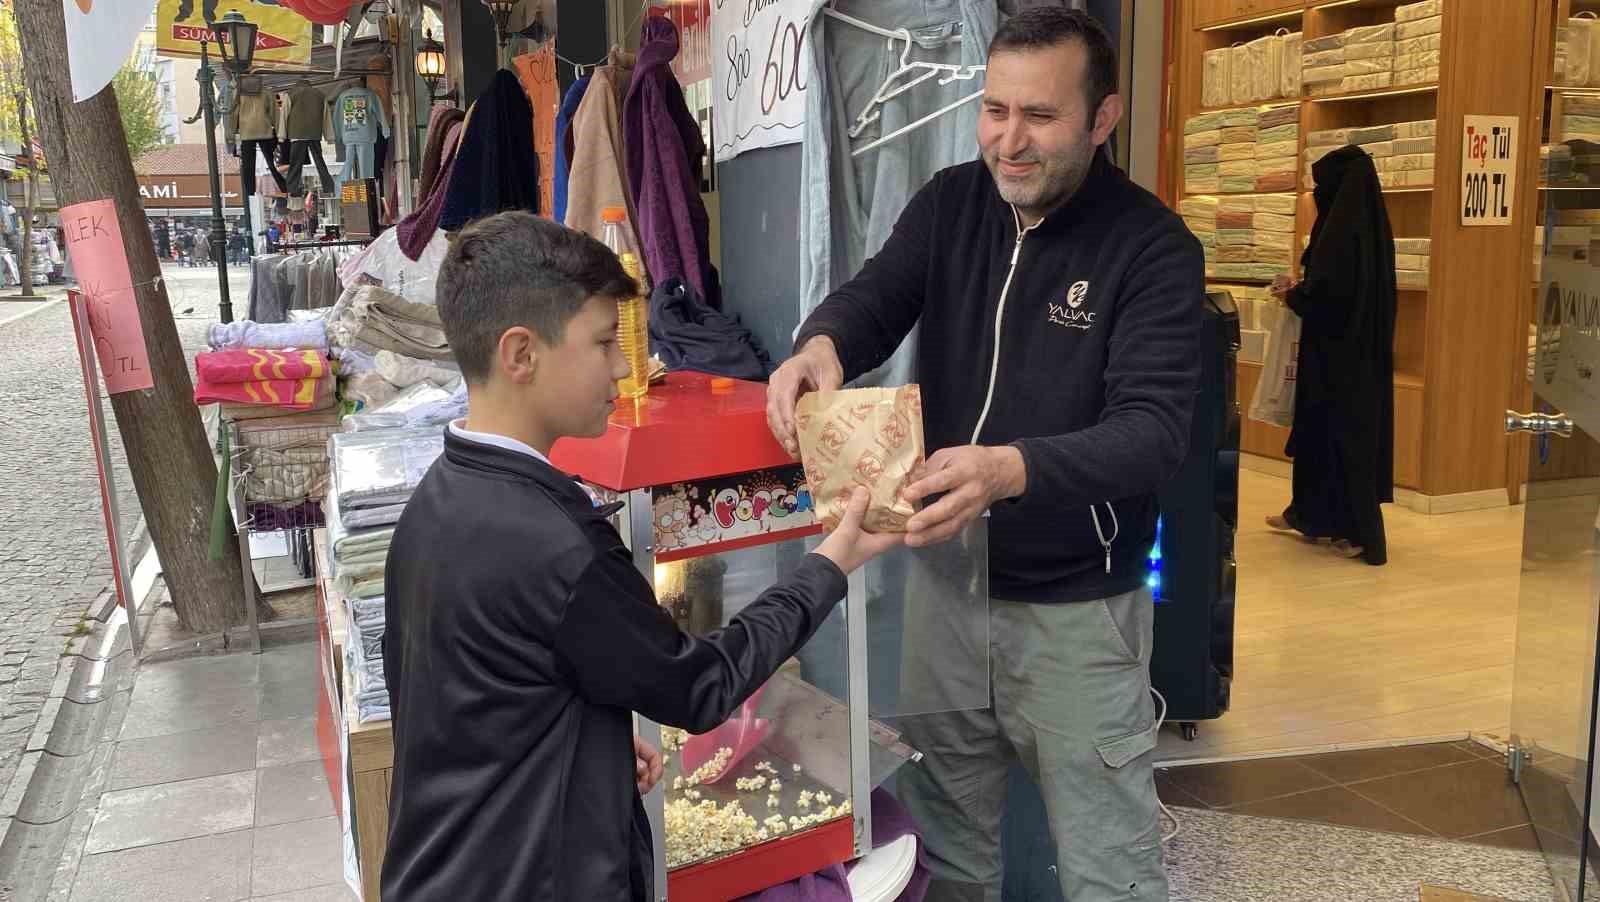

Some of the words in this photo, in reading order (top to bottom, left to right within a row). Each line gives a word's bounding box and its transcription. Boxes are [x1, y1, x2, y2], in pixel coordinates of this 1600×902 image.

[726, 34, 750, 101] 800
[1466, 126, 1488, 168] Taç
[1492, 126, 1511, 159] Tül
[1464, 172, 1488, 218] 200
[1492, 173, 1508, 217] TL
[67, 215, 110, 243] LEK
